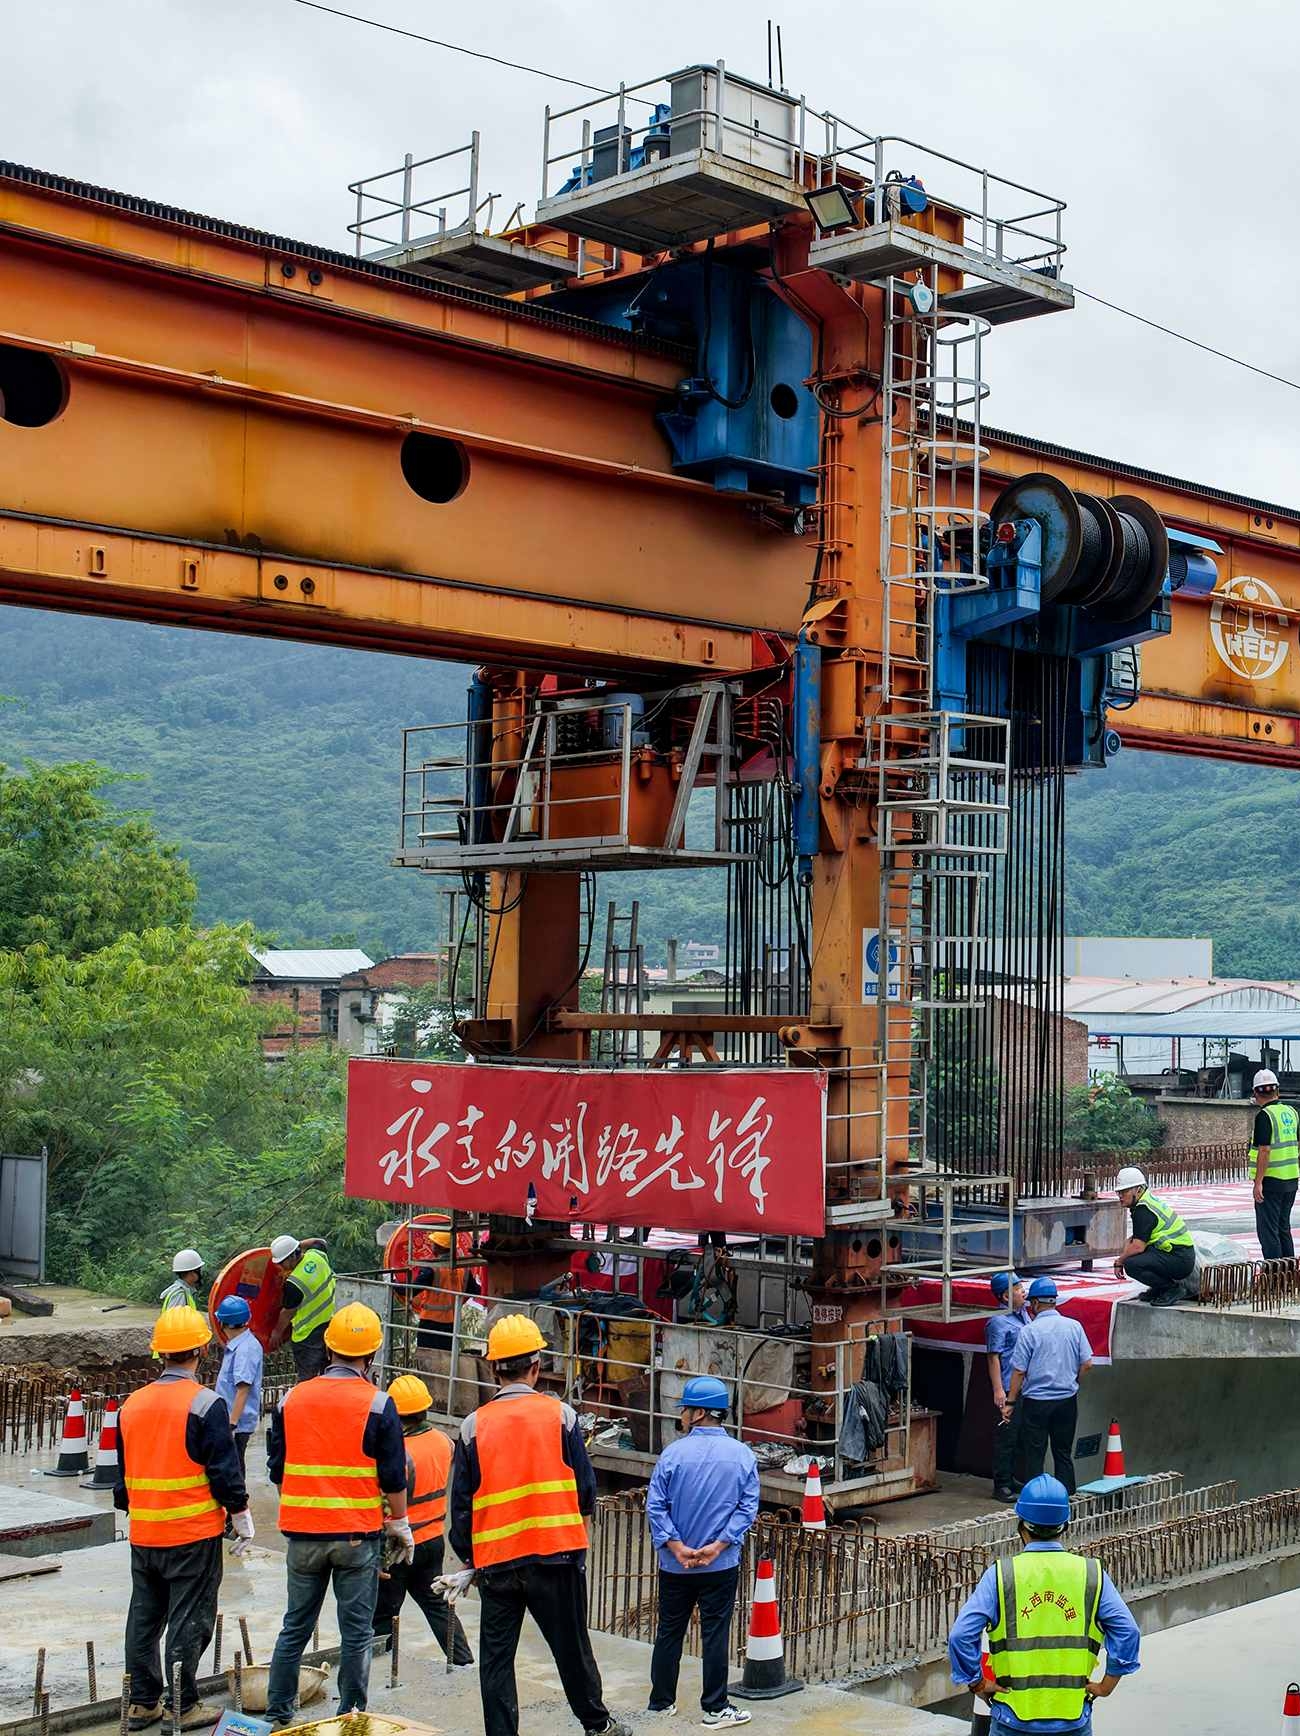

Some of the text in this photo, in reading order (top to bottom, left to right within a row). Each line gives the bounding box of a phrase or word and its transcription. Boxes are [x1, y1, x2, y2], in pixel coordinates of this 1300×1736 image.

[1020, 1590, 1077, 1622] 大西南监理
